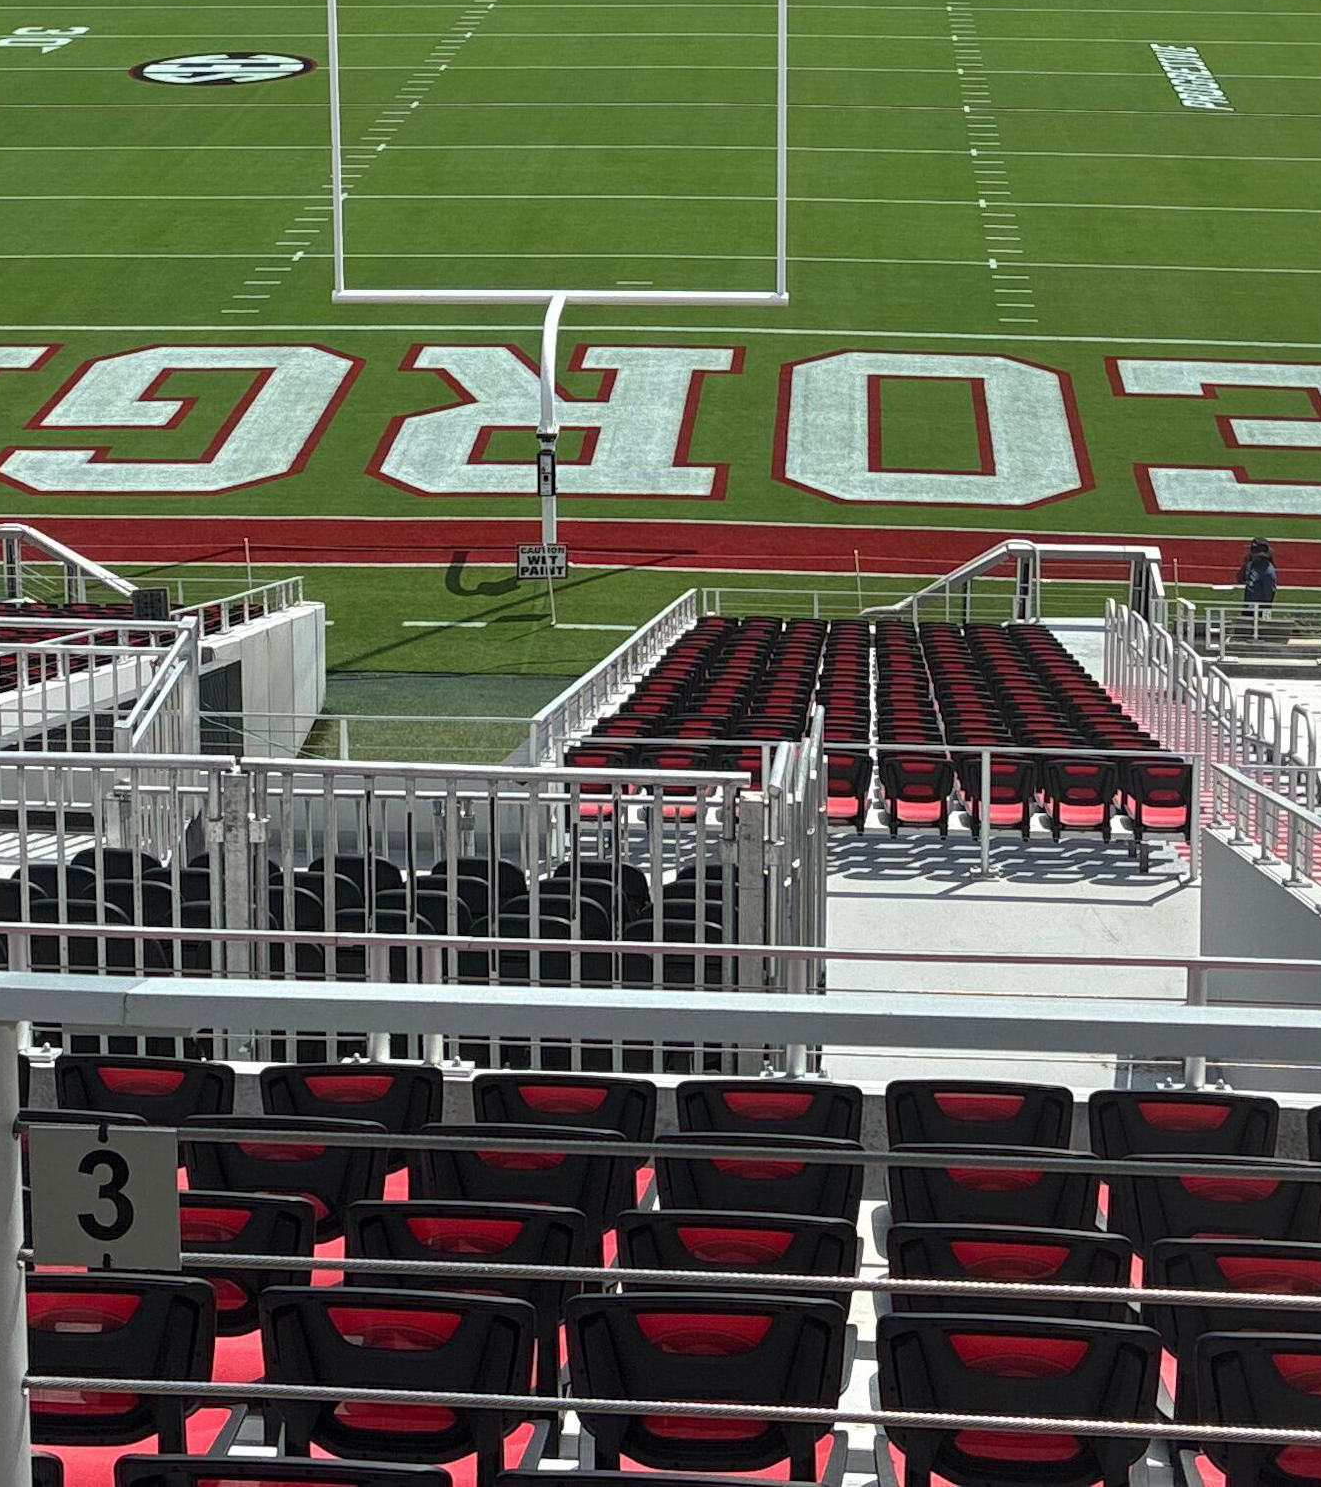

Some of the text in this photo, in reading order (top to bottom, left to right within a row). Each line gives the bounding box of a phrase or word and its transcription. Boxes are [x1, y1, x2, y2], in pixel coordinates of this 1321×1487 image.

[1149, 43, 1235, 112] PROGRESSIVE
[520, 546, 565, 554] CAUTION
[527, 555, 558, 565] WET
[520, 566, 564, 576] PAINT
[77, 1149, 135, 1241] 3
